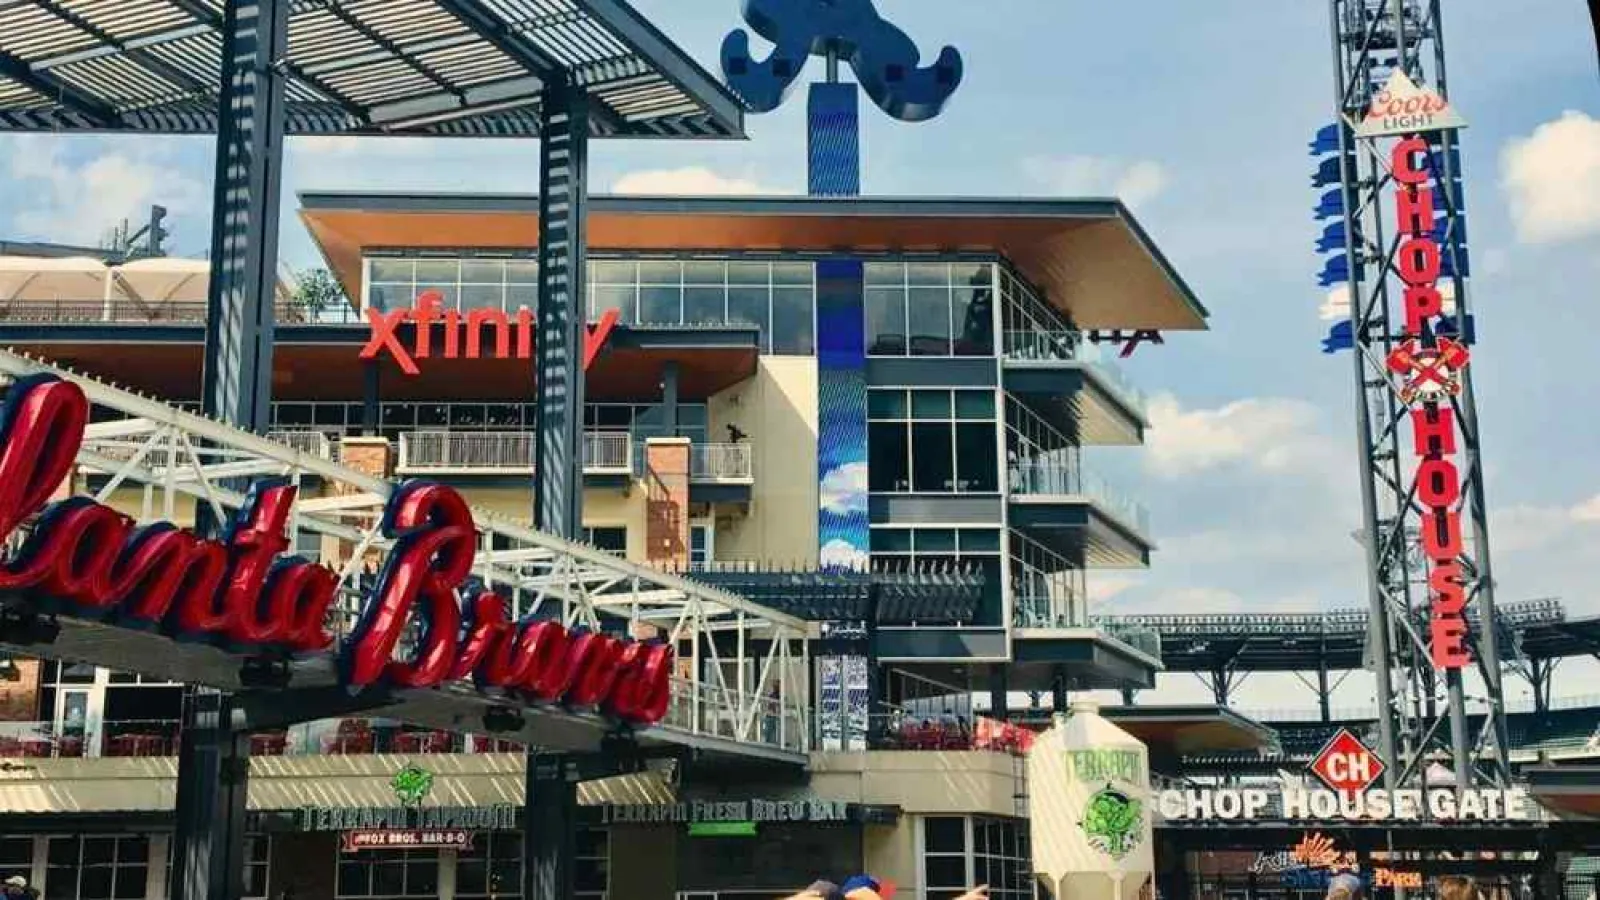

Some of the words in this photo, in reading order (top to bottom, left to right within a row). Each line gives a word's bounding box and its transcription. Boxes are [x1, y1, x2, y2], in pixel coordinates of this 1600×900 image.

[1369, 91, 1446, 117] Coors
[1383, 114, 1434, 129] LIGHT
[1391, 137, 1442, 334] CHOP
[359, 288, 621, 375] xfiniy
[1410, 407, 1471, 670] HOUSE
[337, 479, 671, 725] Braves
[1326, 752, 1371, 782] CH
[691, 800, 747, 822] FRESH
[751, 799, 804, 822] BREW
[809, 799, 847, 821] BAR
[1158, 788, 1269, 819] CHOP
[1283, 788, 1418, 819] HOUSE
[1430, 787, 1527, 819] GATE
